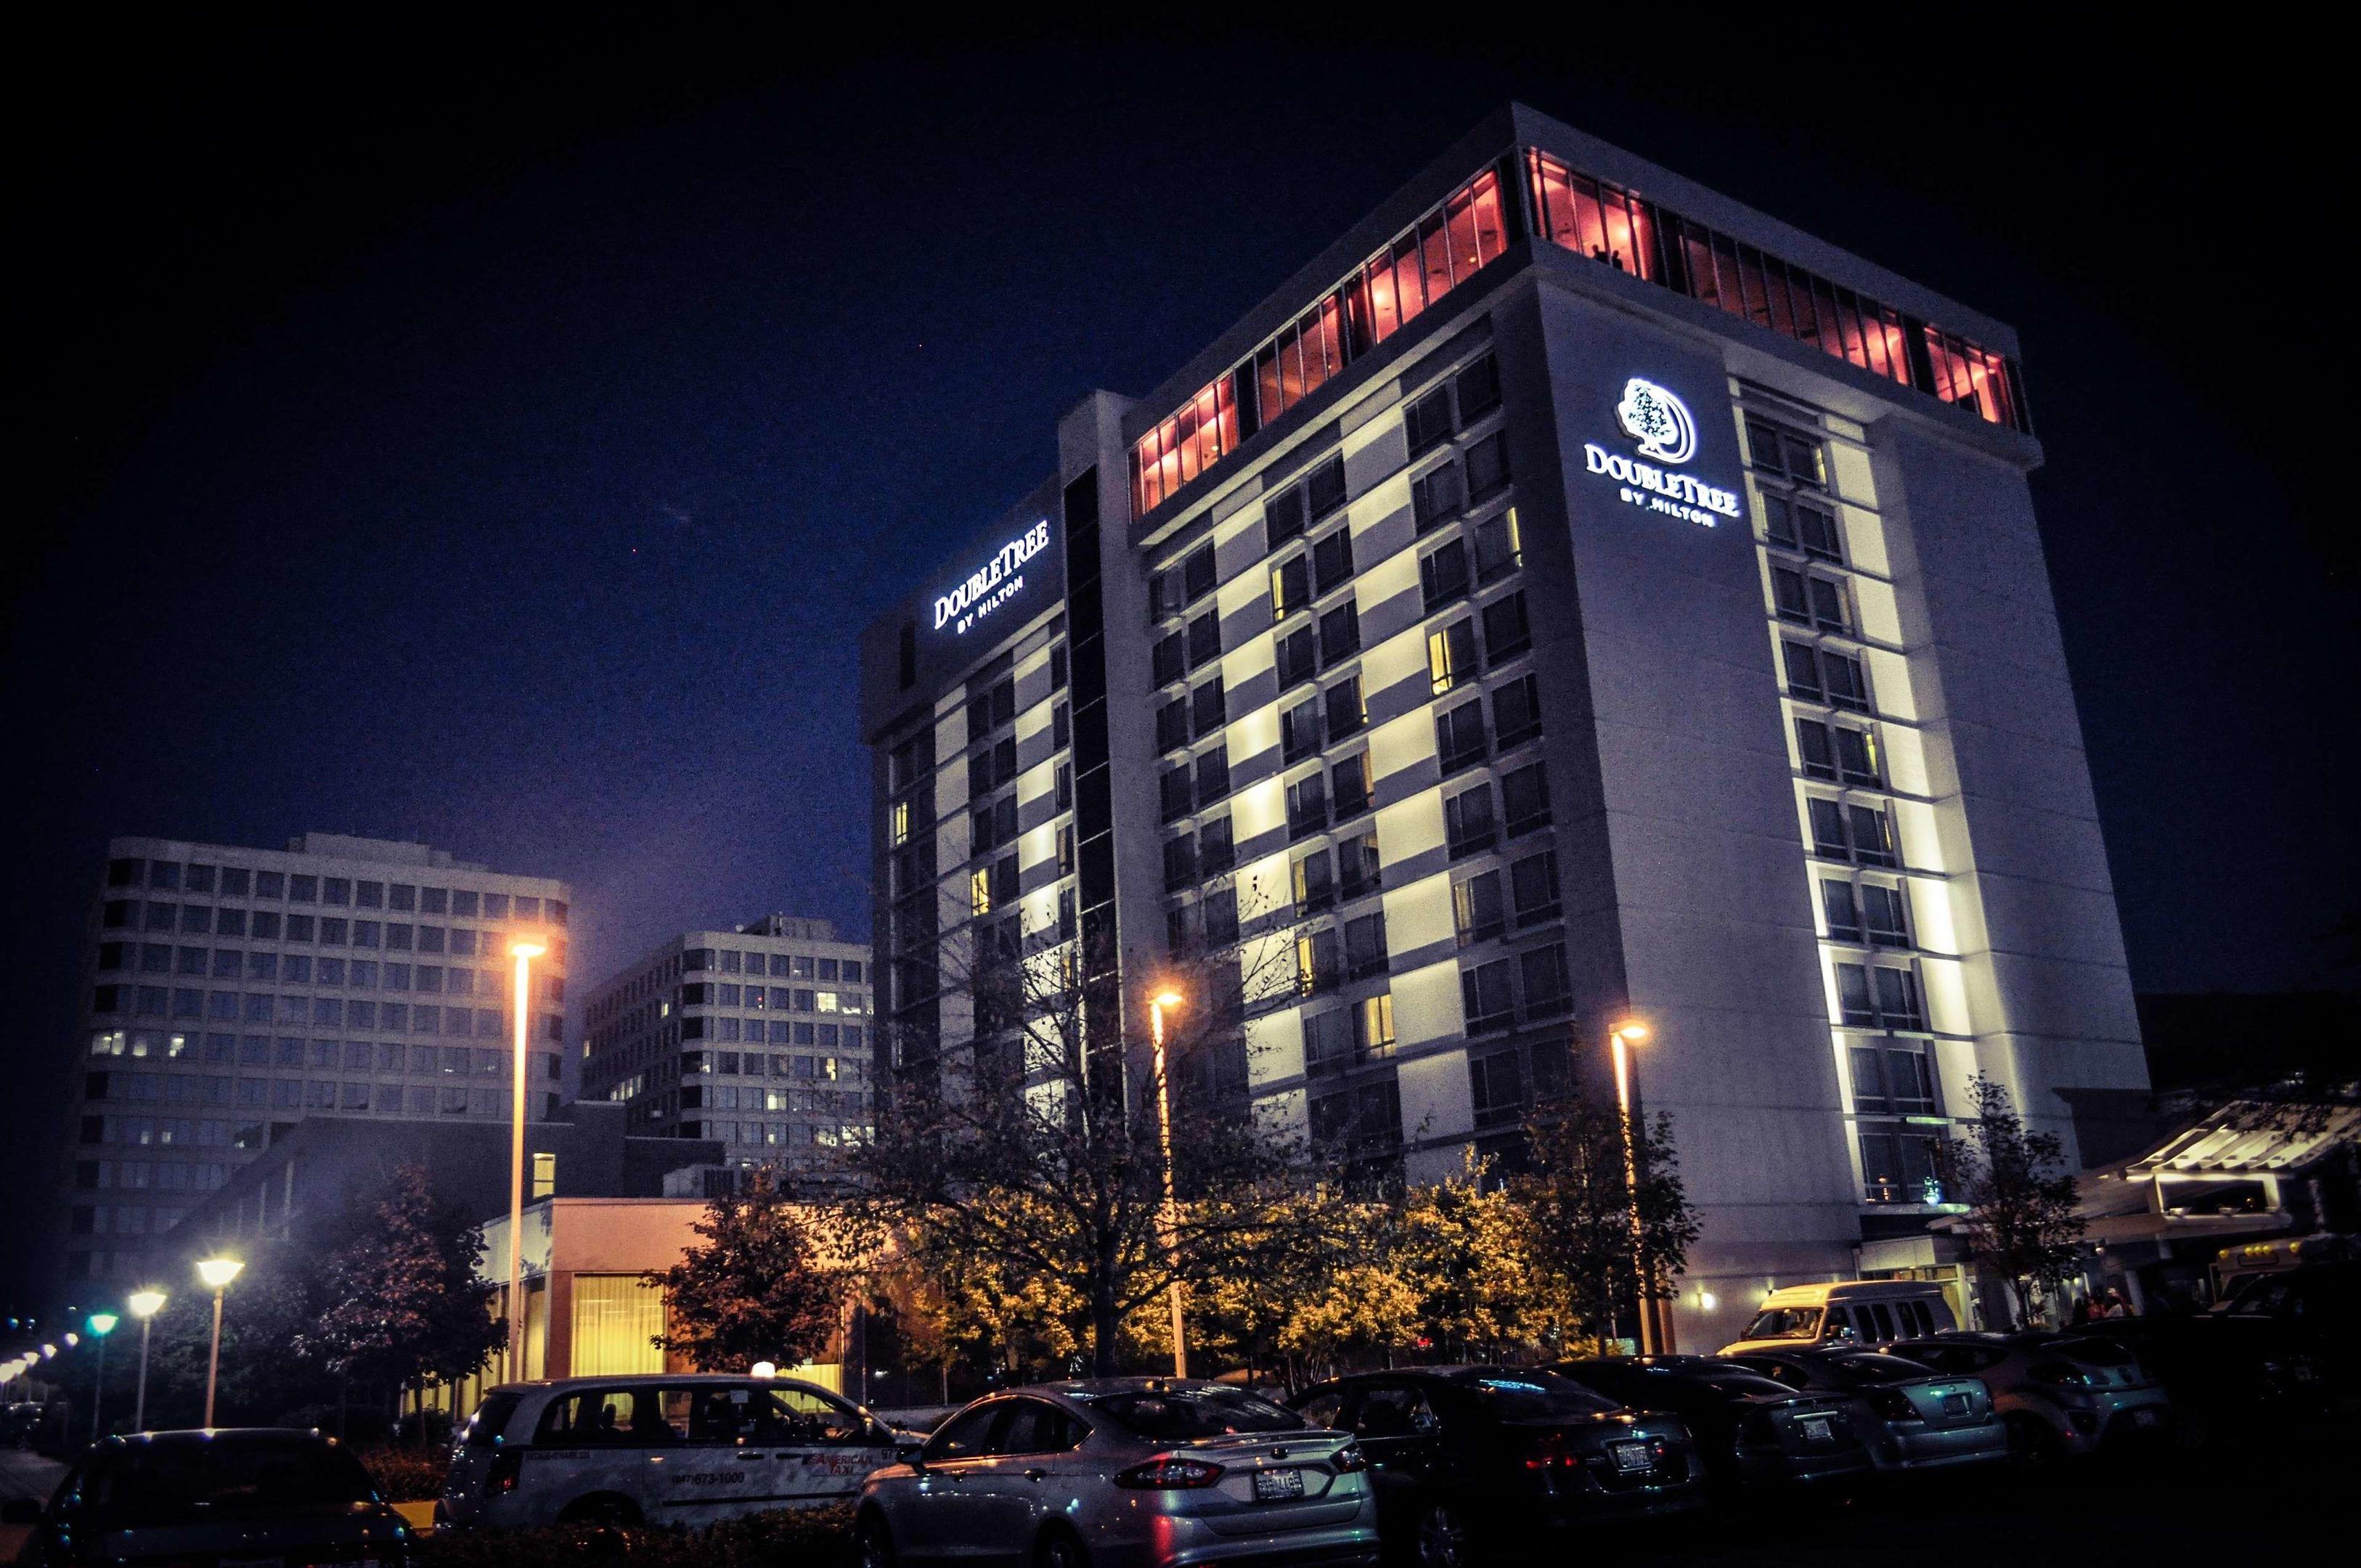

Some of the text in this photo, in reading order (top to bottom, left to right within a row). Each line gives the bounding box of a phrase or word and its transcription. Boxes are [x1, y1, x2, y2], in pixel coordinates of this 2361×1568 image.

[1582, 444, 1740, 518] DOUBLETREE
[1620, 488, 1716, 528] BY HILTON
[934, 520, 1049, 629] DOUBLETREE
[957, 576, 1023, 634] BY HILTON
[817, 1453, 873, 1465] AMERICAN
[830, 1464, 855, 1475] TAXI
